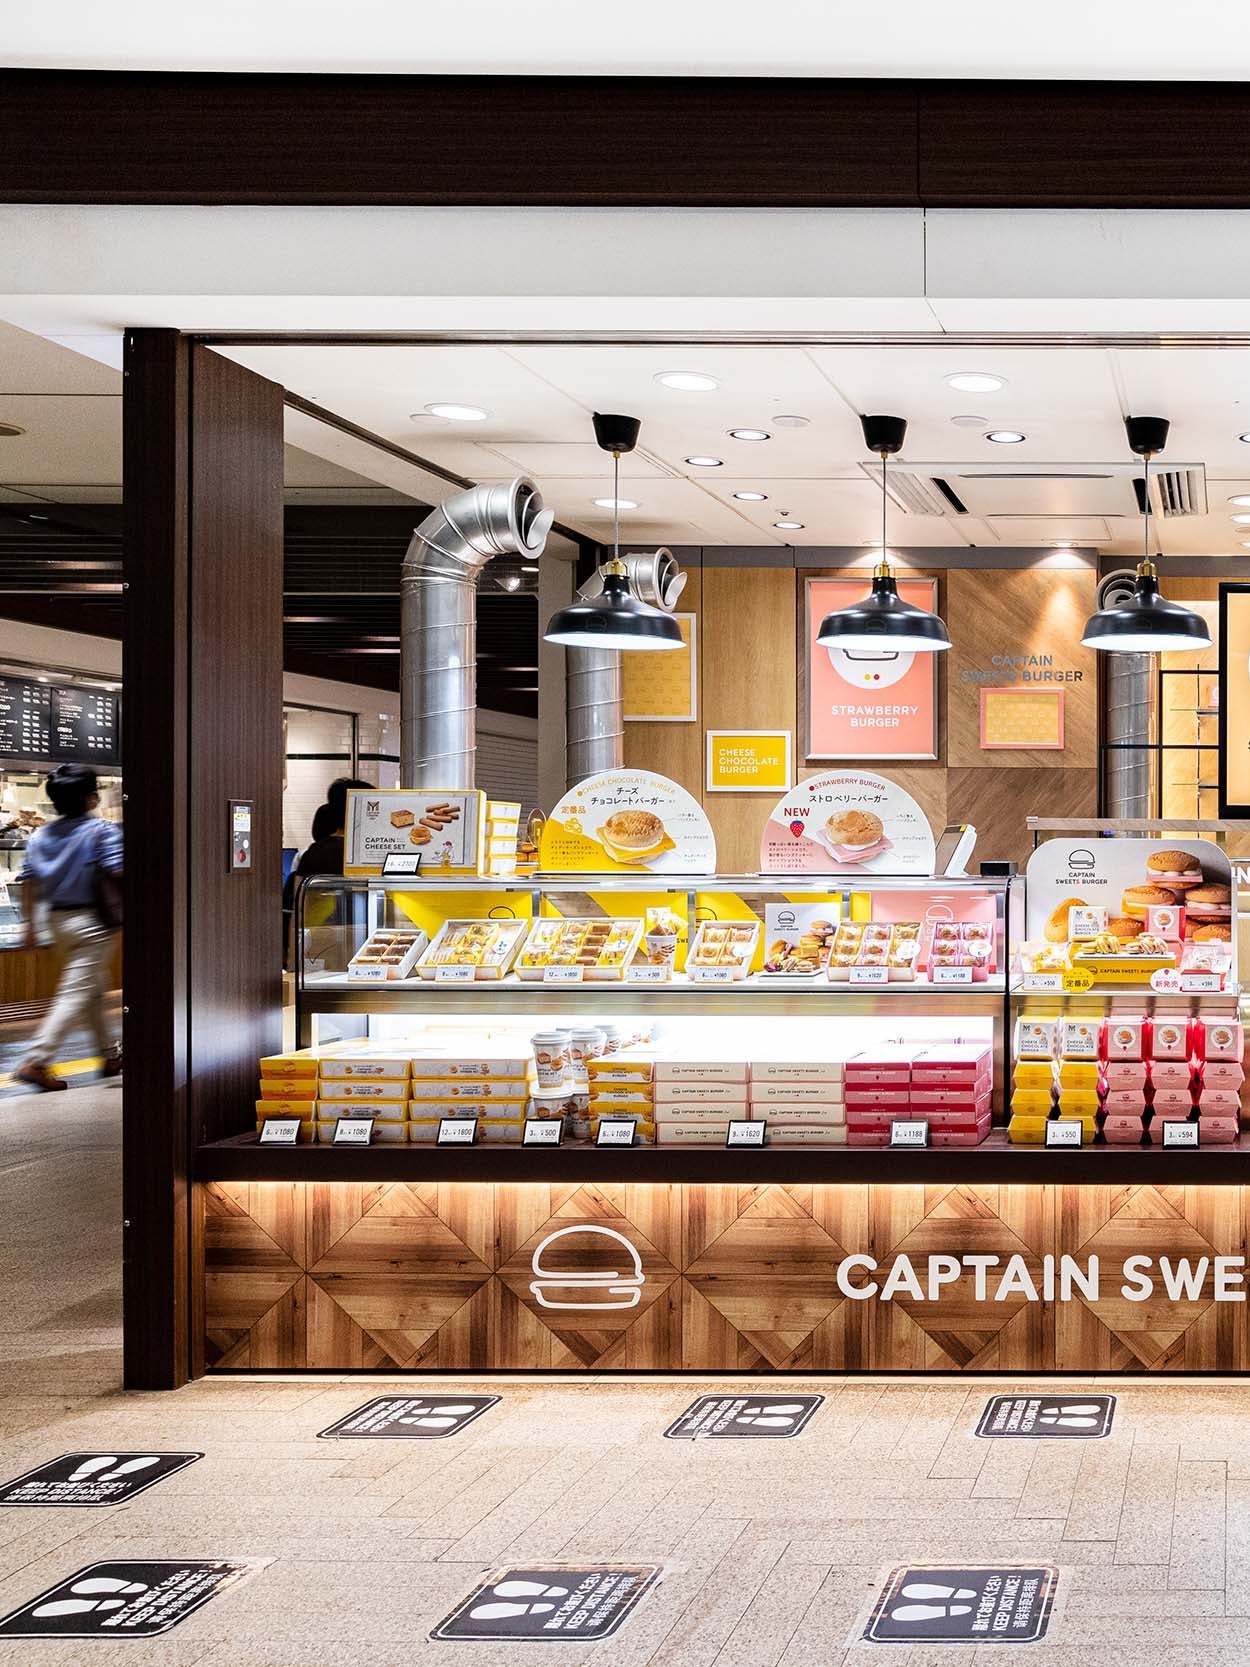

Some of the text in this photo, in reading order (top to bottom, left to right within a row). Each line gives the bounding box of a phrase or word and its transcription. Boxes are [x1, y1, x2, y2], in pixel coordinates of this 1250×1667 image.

[991, 655, 1053, 666] CAPTAIN
[1022, 671, 1083, 681] BURGER
[831, 705, 918, 716] STRAWBERRY
[850, 718, 900, 727] BURGER
[719, 757, 779, 765] CHOCOLATE
[814, 778, 886, 791] STRAWBERRY BURGER
[616, 787, 639, 795] チーズ
[591, 797, 665, 805] チョコレートバーガー
[809, 794, 888, 803] ストロベリーバーガー
[561, 806, 587, 814] 定番品
[784, 807, 811, 817] NEW
[1155, 980, 1179, 988] 新発売
[837, 1254, 1099, 1302] CAPTAIN
[970, 1575, 1003, 1630] 離れてお並びください
[119, 1606, 161, 1626] KEEP
[563, 1610, 592, 1628] KEEP
[991, 1612, 1011, 1630] KEEP
